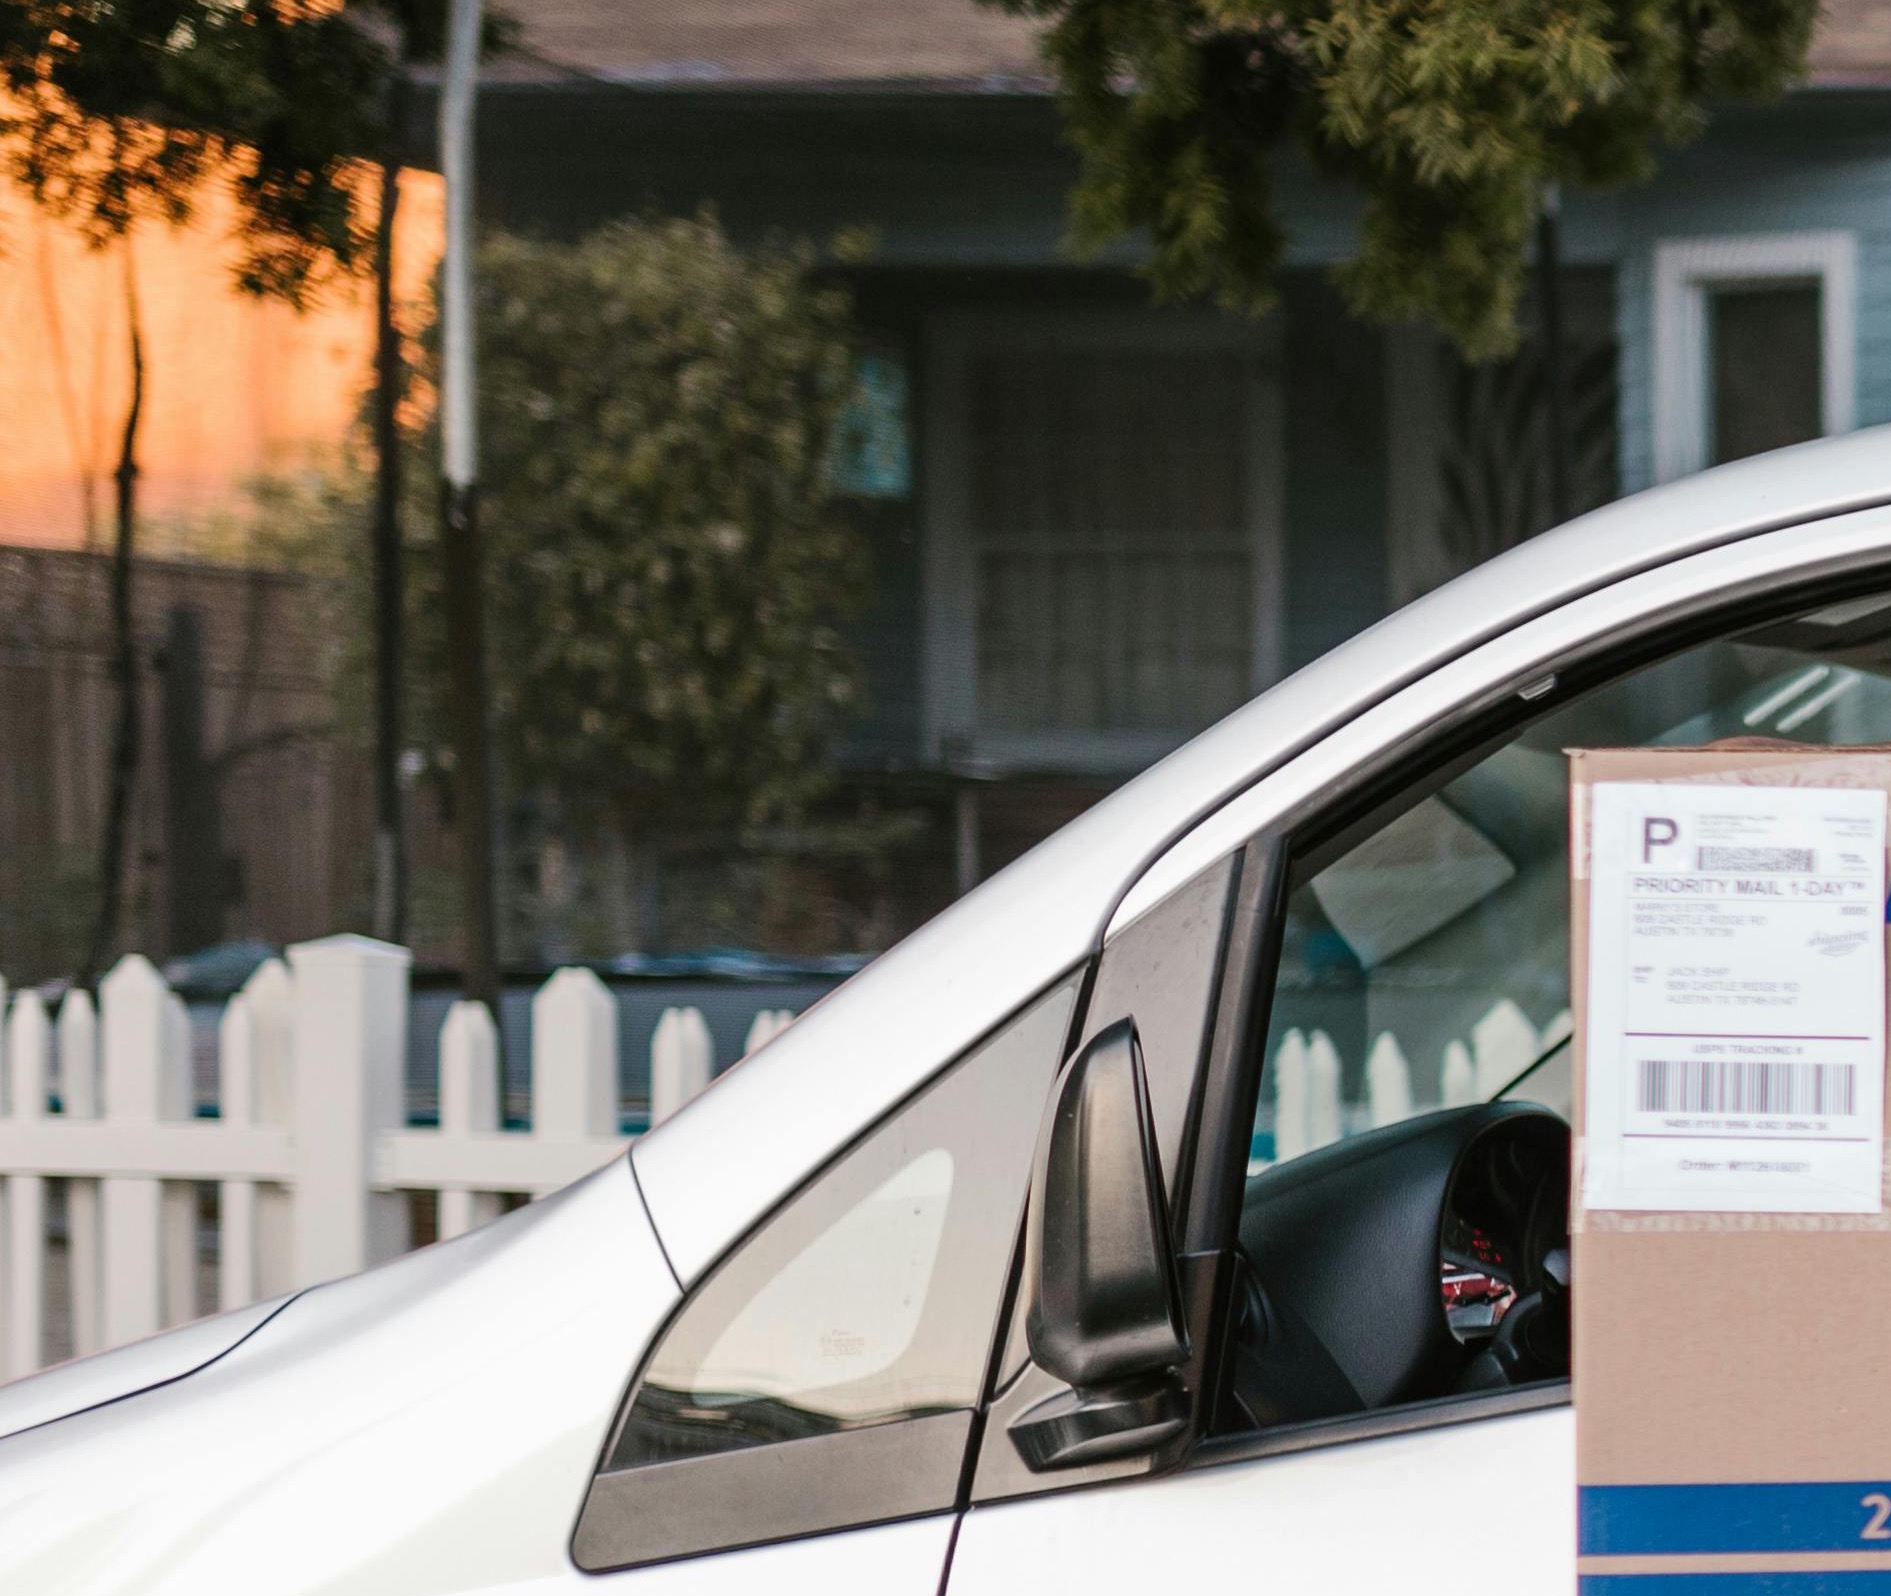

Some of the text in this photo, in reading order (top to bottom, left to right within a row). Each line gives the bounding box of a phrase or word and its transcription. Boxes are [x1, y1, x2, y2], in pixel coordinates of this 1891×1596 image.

[1644, 817, 1679, 863] P
[1633, 877, 1727, 894] PRIORITY
[1735, 879, 1783, 896] MAIL
